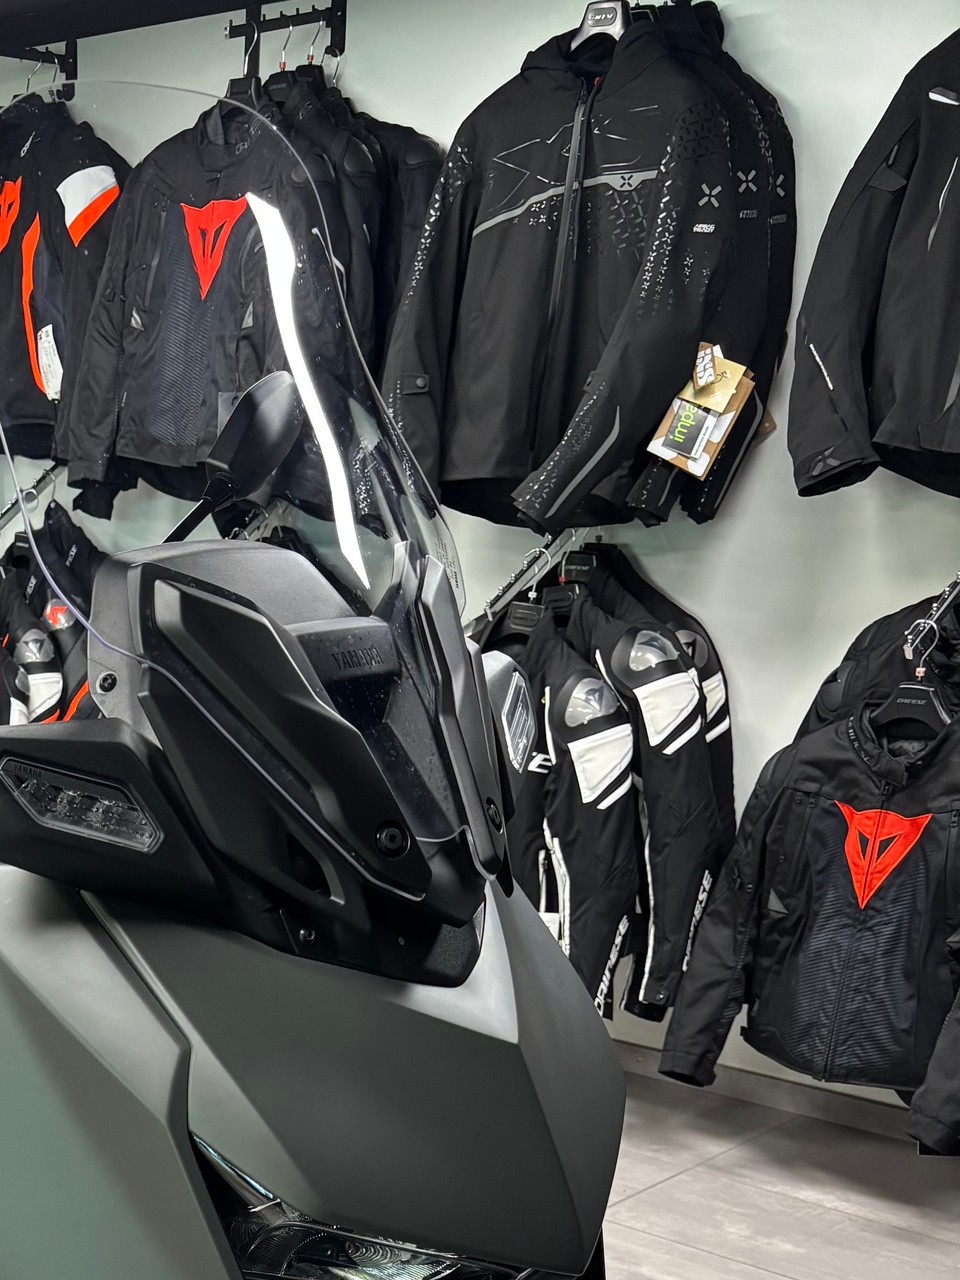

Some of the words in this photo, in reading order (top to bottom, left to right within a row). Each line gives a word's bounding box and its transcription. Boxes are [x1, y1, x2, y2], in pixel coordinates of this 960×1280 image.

[330, 645, 385, 671] YAMAHA
[13, 763, 42, 779] YAMAHA
[594, 914, 630, 1018] DAINESE
